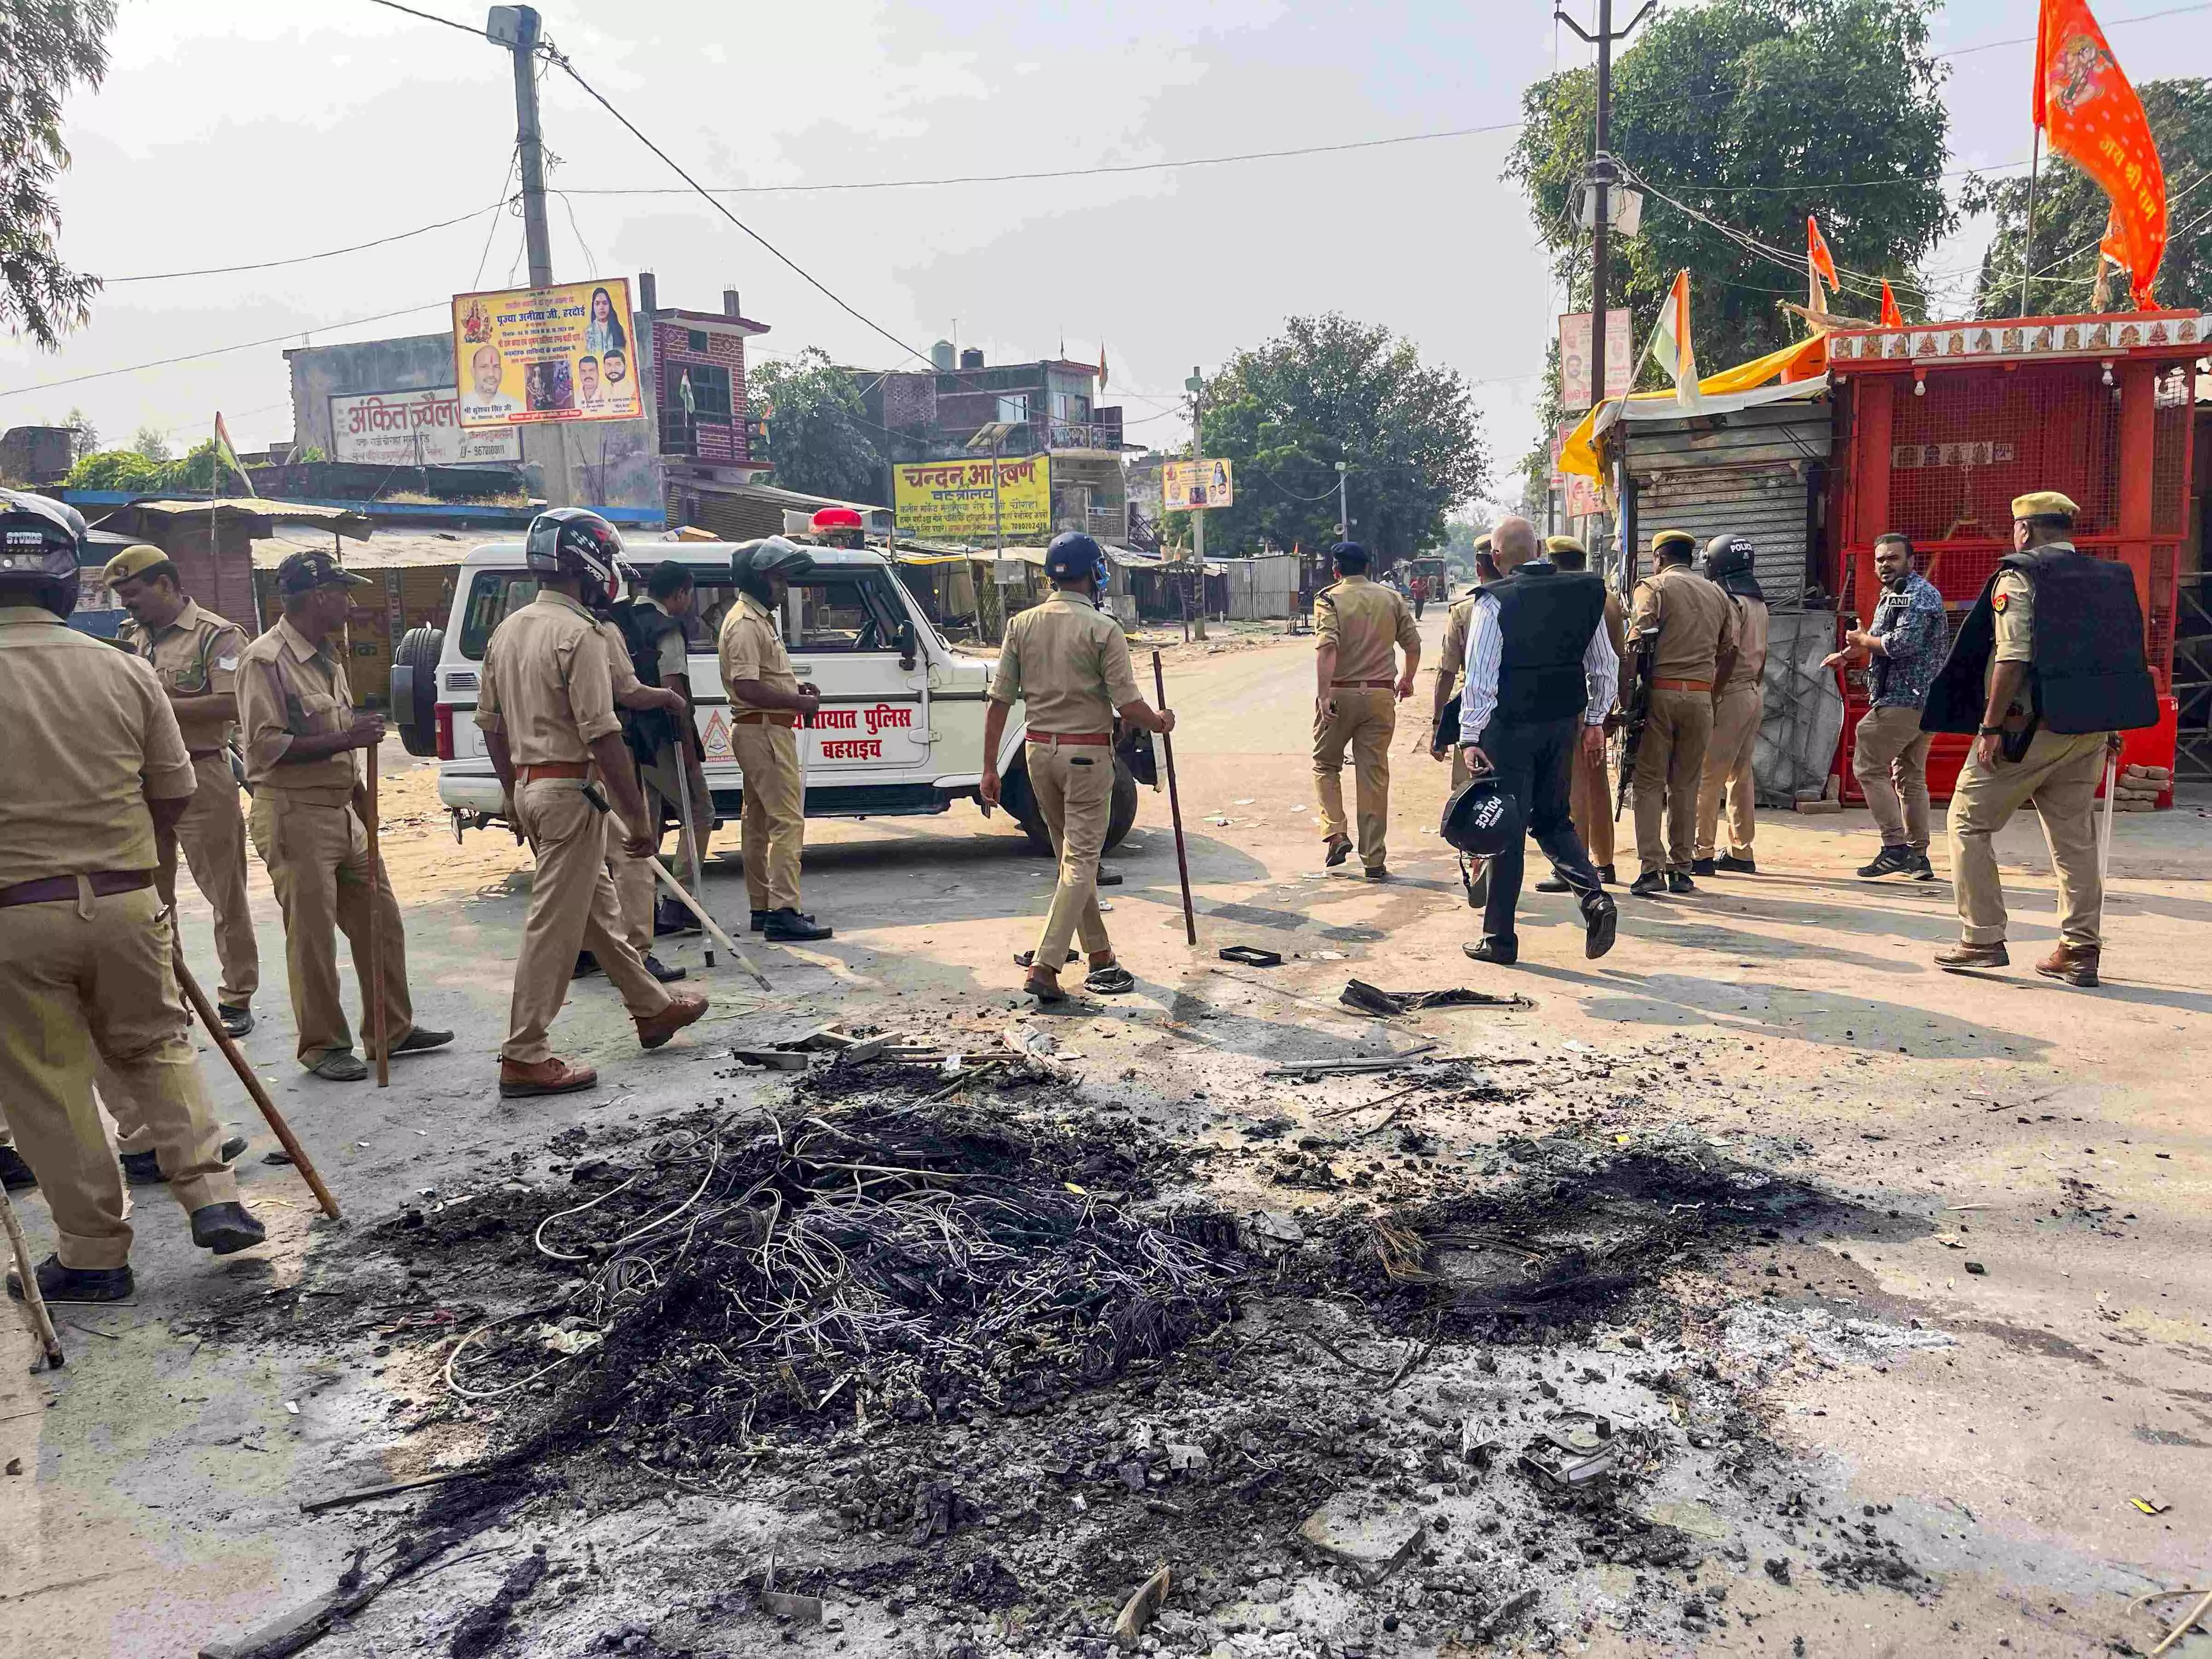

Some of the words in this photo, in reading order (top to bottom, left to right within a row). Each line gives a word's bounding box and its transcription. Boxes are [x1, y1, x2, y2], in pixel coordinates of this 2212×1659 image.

[519, 310, 545, 321] अनीता
[562, 305, 586, 317] हरदोई
[349, 397, 408, 434] अंकित
[902, 465, 965, 489] चन्दन
[793, 709, 857, 729] यतायात
[864, 705, 912, 735] पुलिस
[820, 740, 882, 760] बहराइच
[1475, 796, 1502, 829] POLICE
